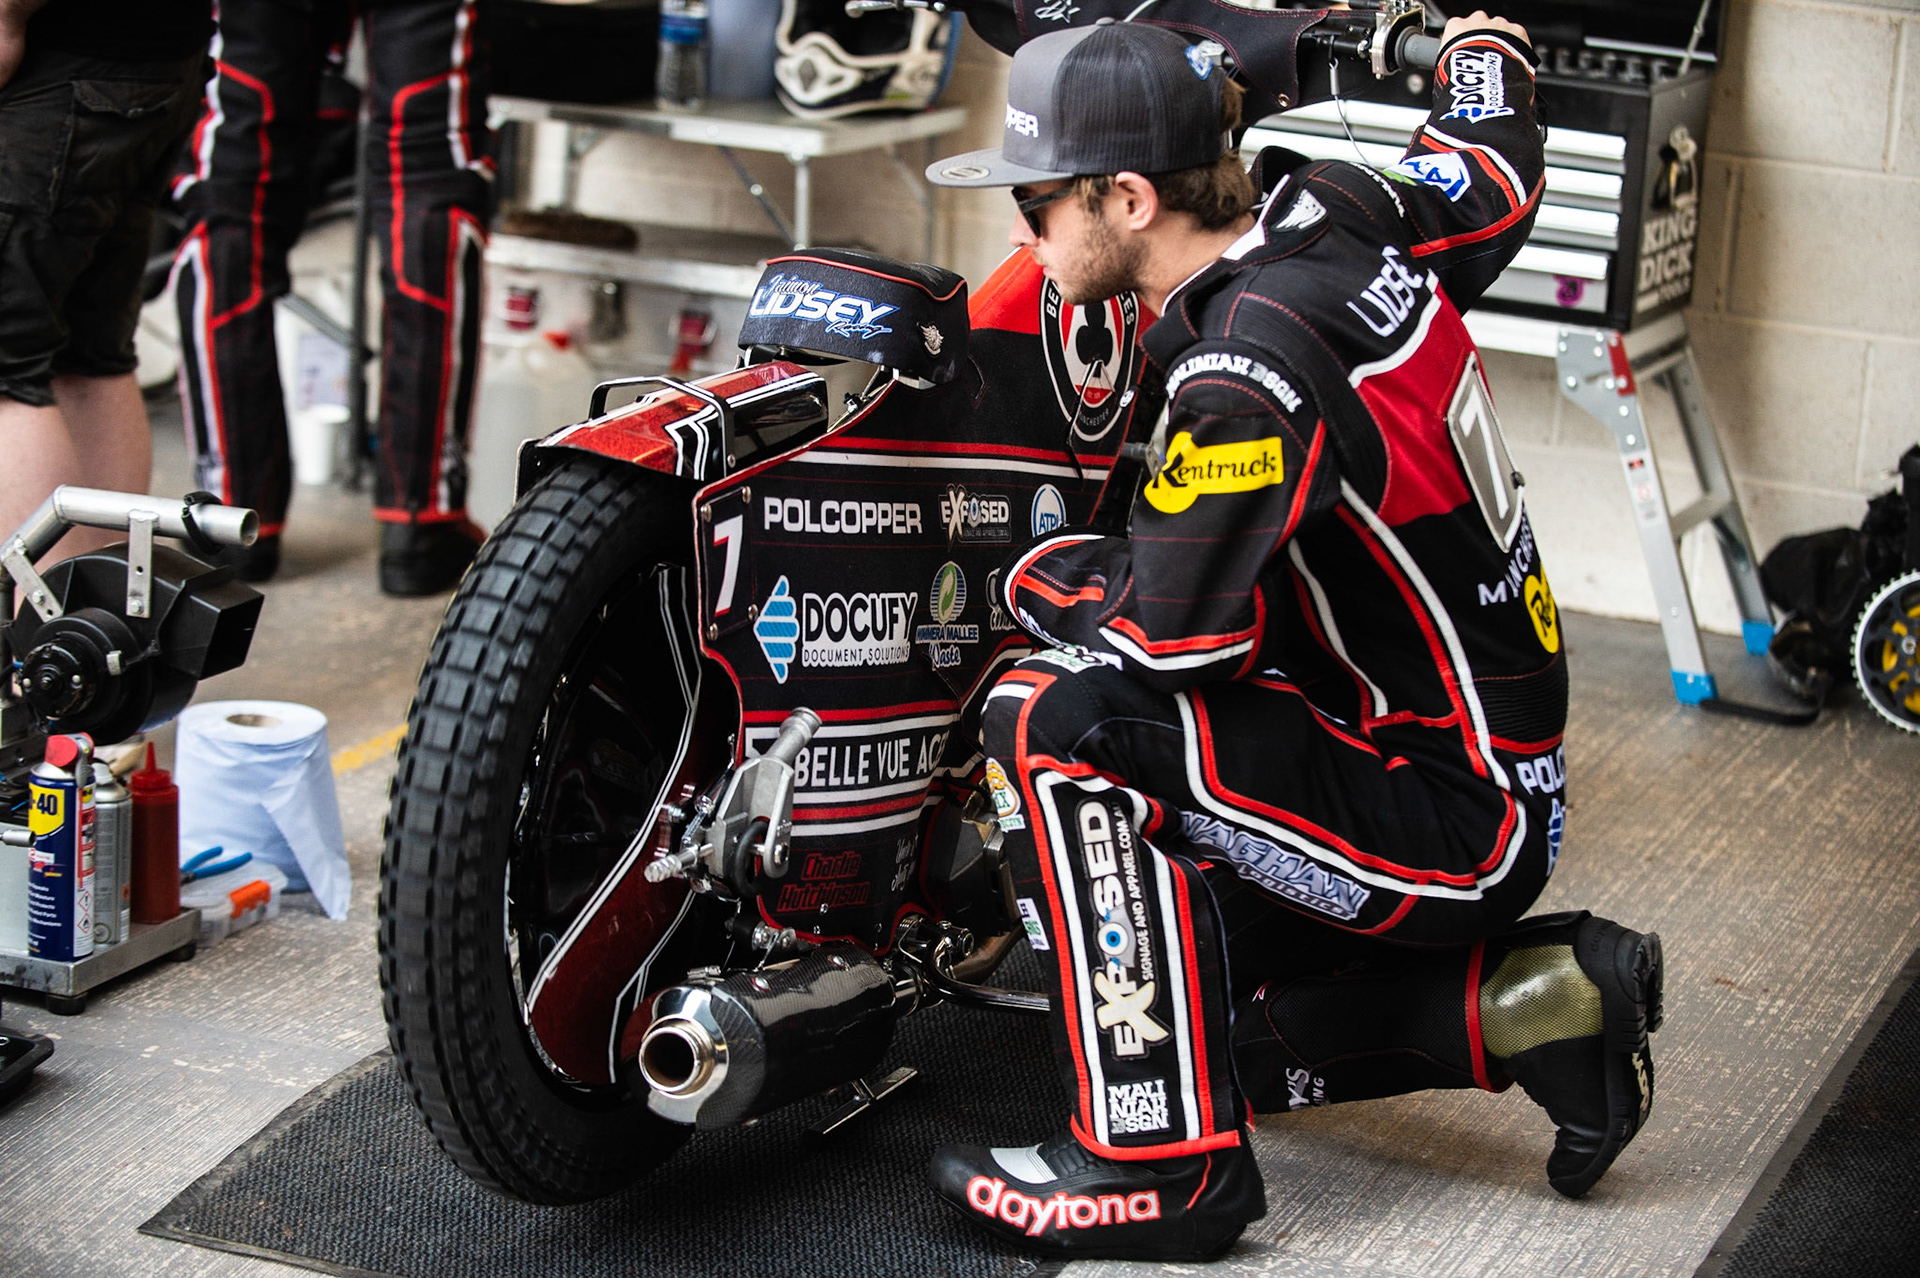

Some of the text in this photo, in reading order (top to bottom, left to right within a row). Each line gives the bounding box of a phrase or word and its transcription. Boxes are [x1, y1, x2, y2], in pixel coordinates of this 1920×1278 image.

[1643, 205, 1697, 256] KING
[1637, 241, 1694, 293] DICK
[750, 287, 898, 325] LIDSEY
[1459, 384, 1510, 520] 7
[764, 496, 924, 535] POLCOPPER
[940, 490, 1010, 541] EXPOSED
[713, 514, 744, 618] 7
[803, 596, 918, 644] DOCUFY
[945, 626, 979, 641] MALLEE
[803, 644, 910, 663] DOCUMENT SOLUTIONS
[794, 744, 872, 788] BELLE
[877, 737, 911, 781] VUE
[802, 850, 862, 881] Charlie
[1238, 864, 1345, 916] Logistics
[776, 881, 871, 912] Hutchinson
[1132, 903, 1148, 927] AND
[1080, 801, 1170, 1057] EXPOSED
[1136, 929, 1154, 982] SIGNAGE
[966, 1175, 1162, 1237] daytona
